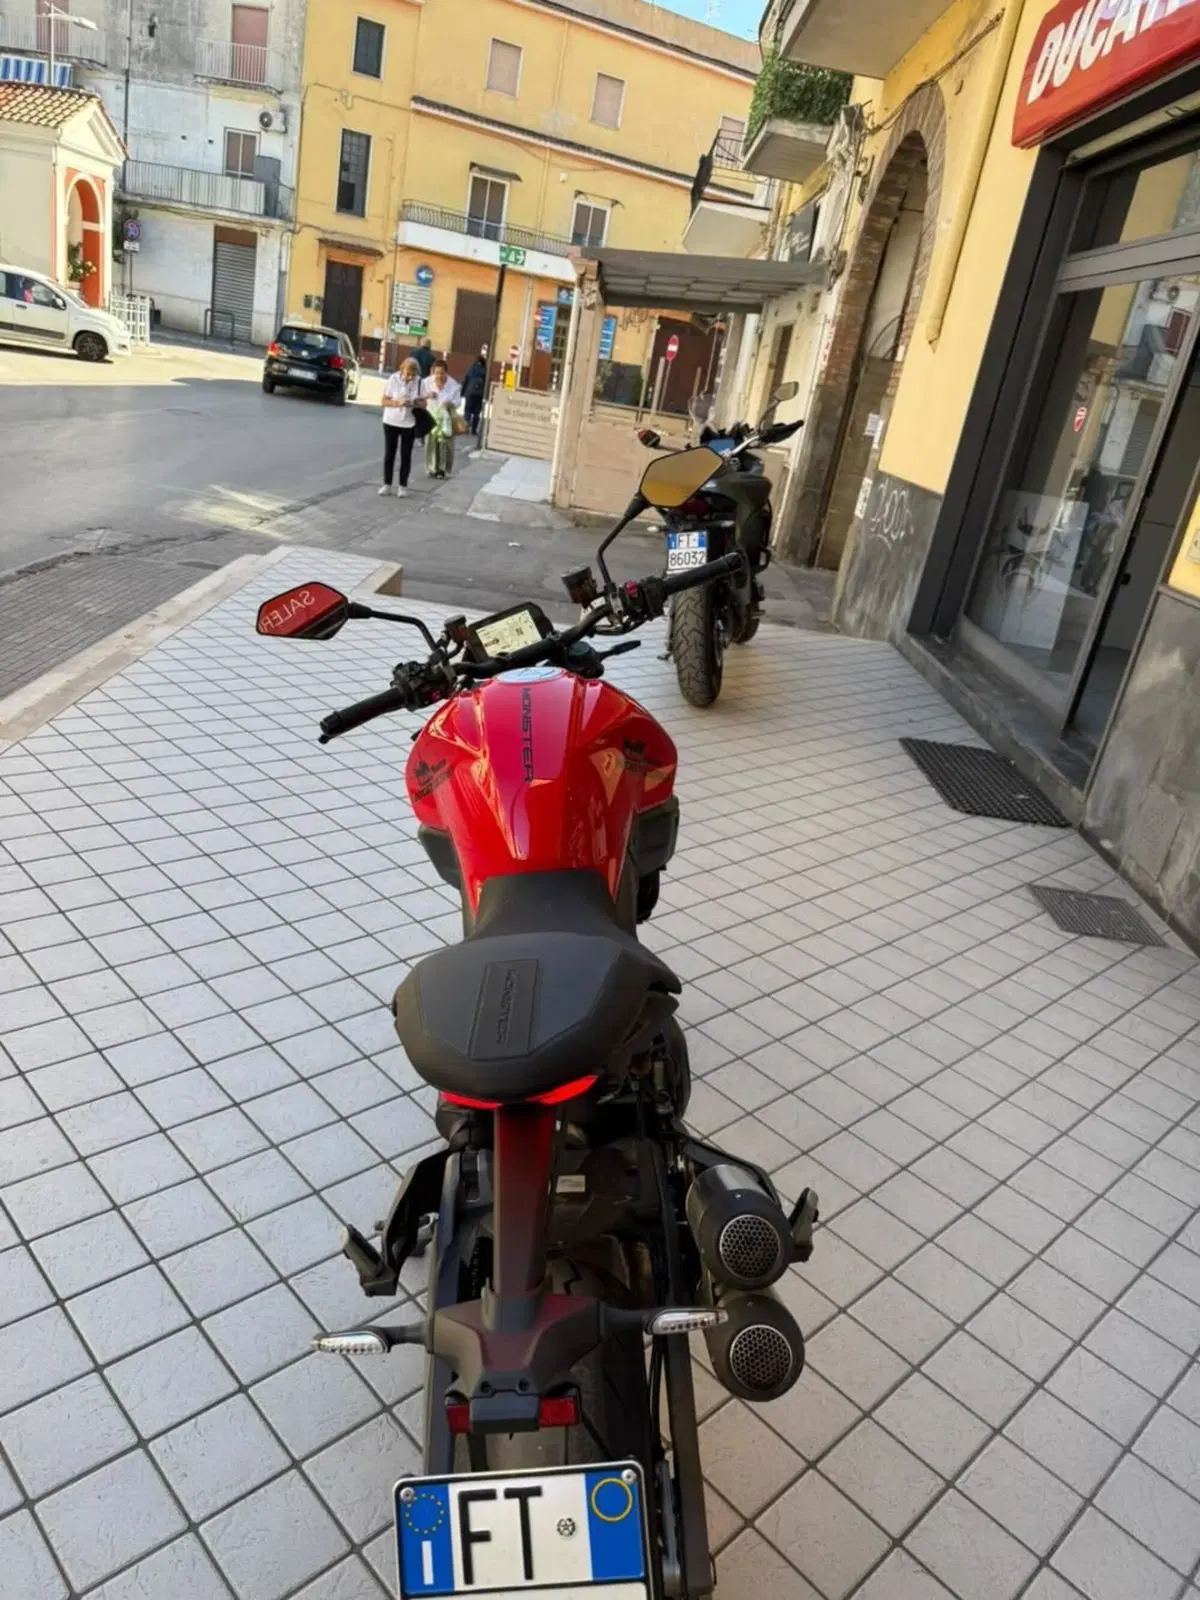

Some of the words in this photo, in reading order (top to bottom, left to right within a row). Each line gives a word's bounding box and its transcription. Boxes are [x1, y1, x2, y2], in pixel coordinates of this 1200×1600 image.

[1027, 0, 1182, 105] DUCA
[670, 551, 705, 566] 86032
[521, 687, 534, 784] MONSTER
[457, 1485, 544, 1585] FT
